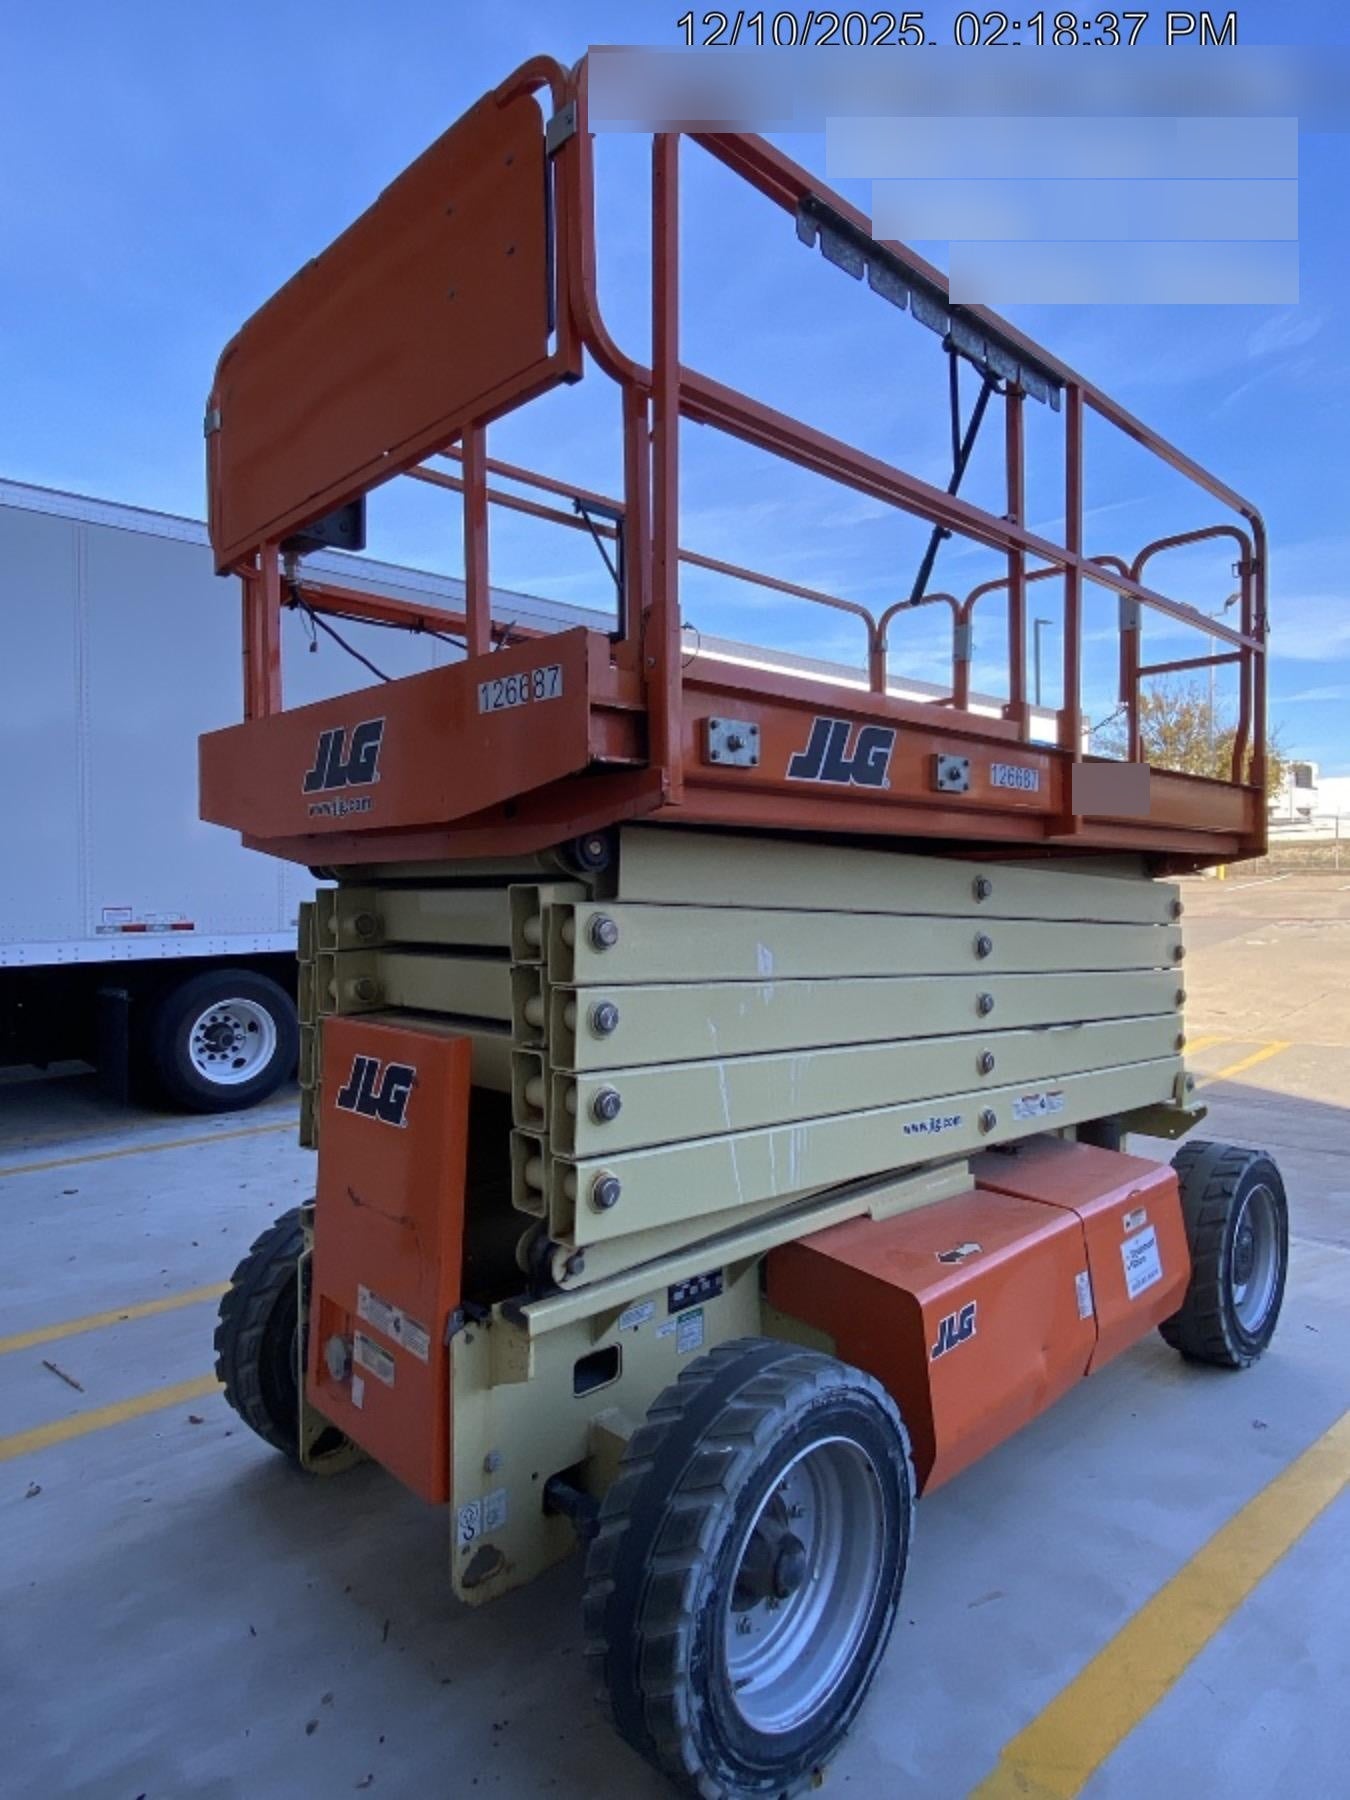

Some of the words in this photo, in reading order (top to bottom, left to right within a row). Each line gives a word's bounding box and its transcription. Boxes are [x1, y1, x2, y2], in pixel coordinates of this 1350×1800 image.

[480, 665, 560, 711] 126687
[302, 716, 385, 794] JLG
[785, 716, 897, 789] JLG
[991, 764, 1038, 791] 126687
[336, 1054, 416, 1128] JLG
[930, 1300, 977, 1362] JLG
